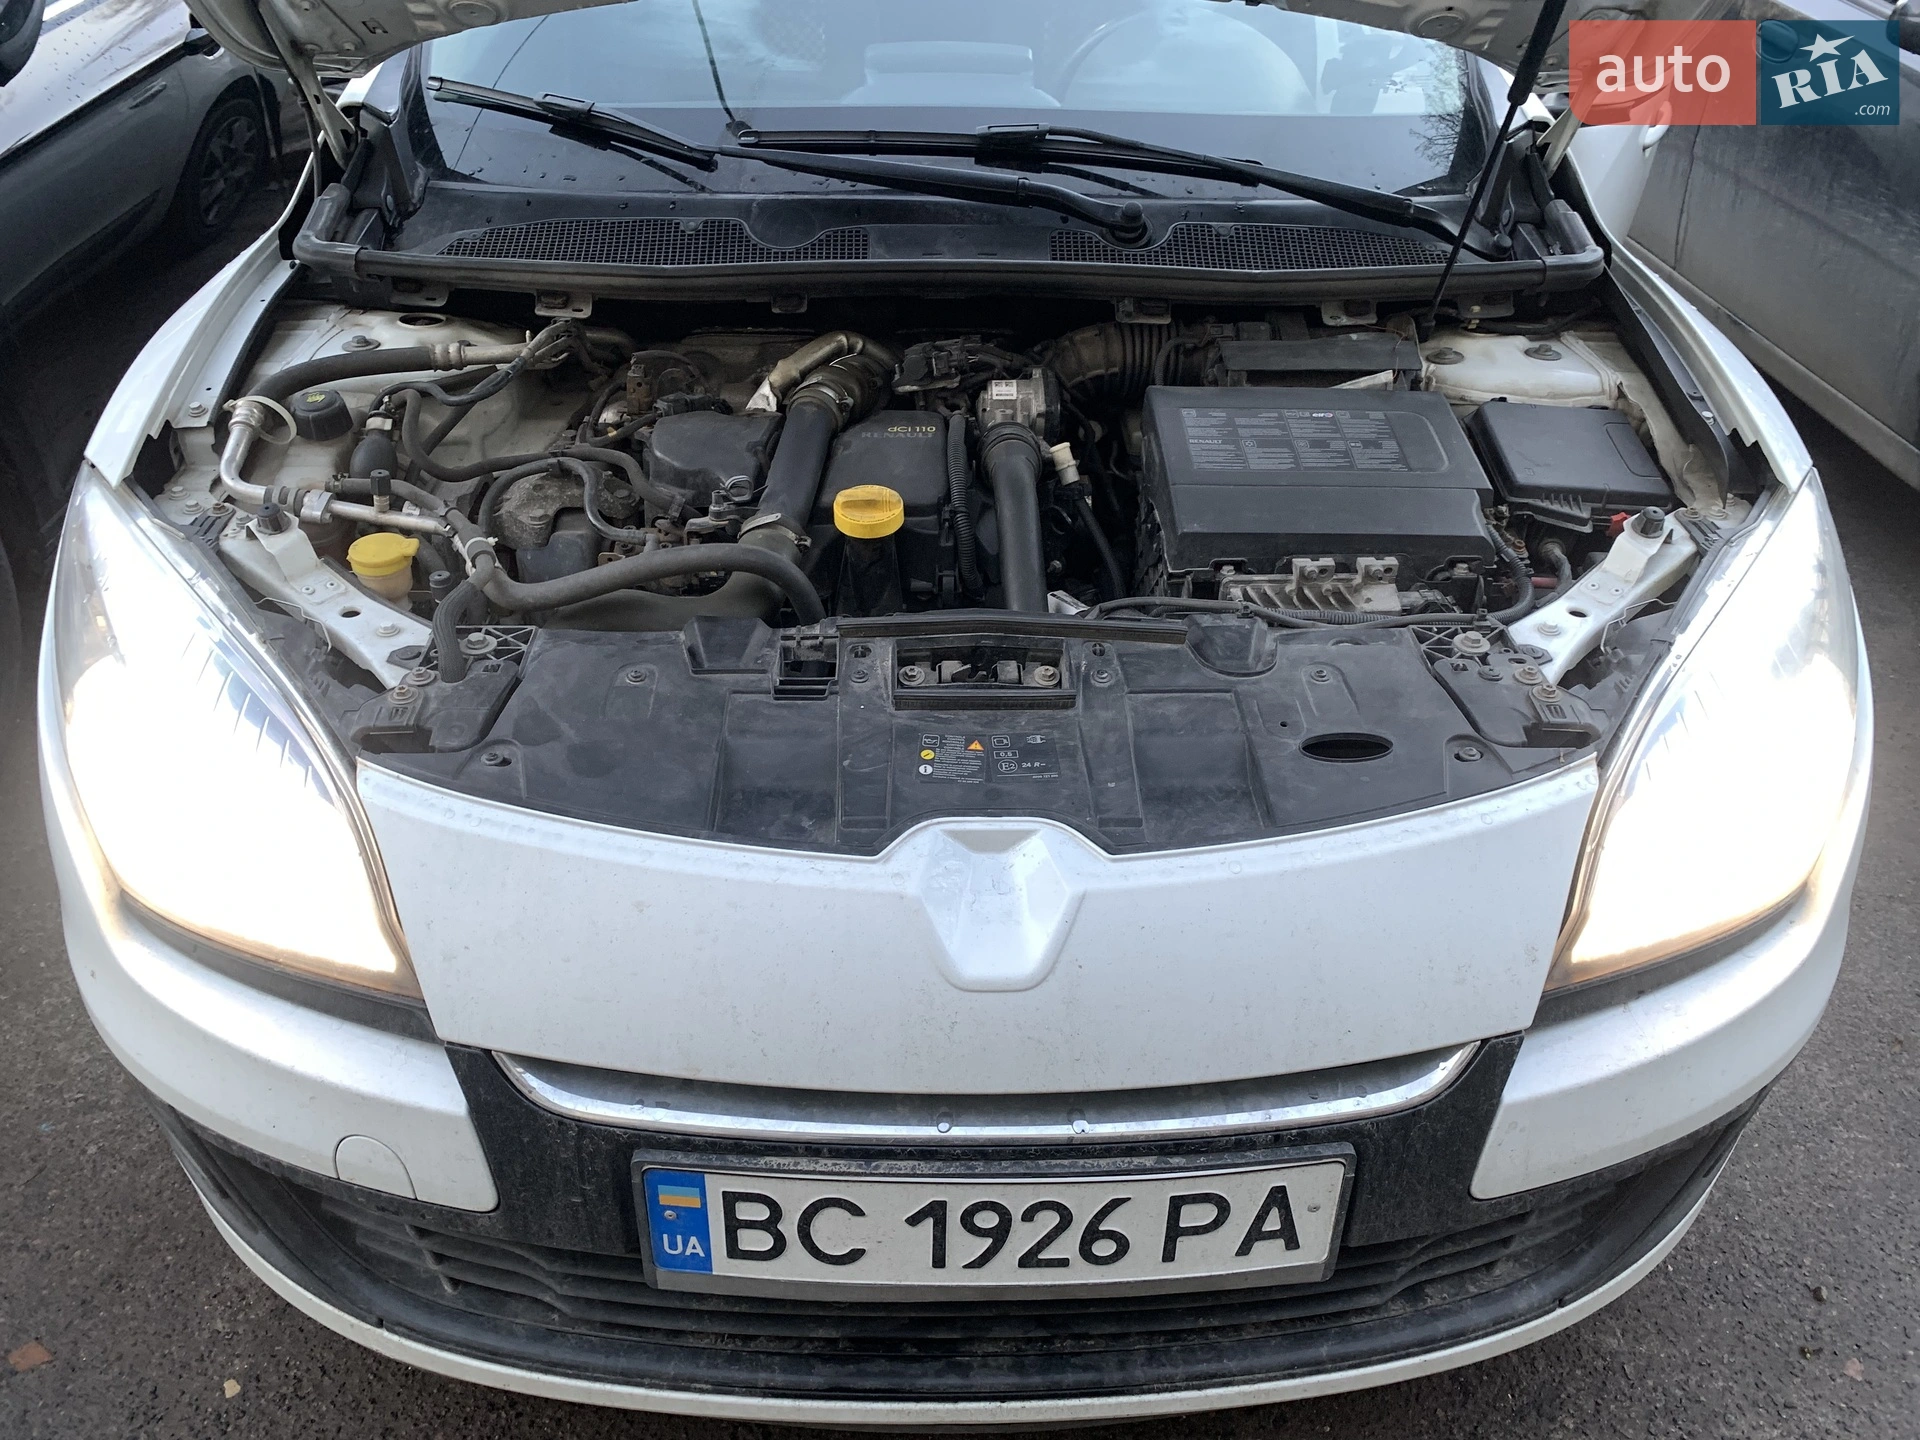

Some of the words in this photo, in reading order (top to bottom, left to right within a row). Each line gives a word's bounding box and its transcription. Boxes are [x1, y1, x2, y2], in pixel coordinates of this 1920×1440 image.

[1001, 762, 1016, 771] E2
[721, 1190, 867, 1266] BC
[904, 1195, 1133, 1270] 1926
[1160, 1184, 1301, 1264] PA
[662, 1233, 706, 1258] UA
